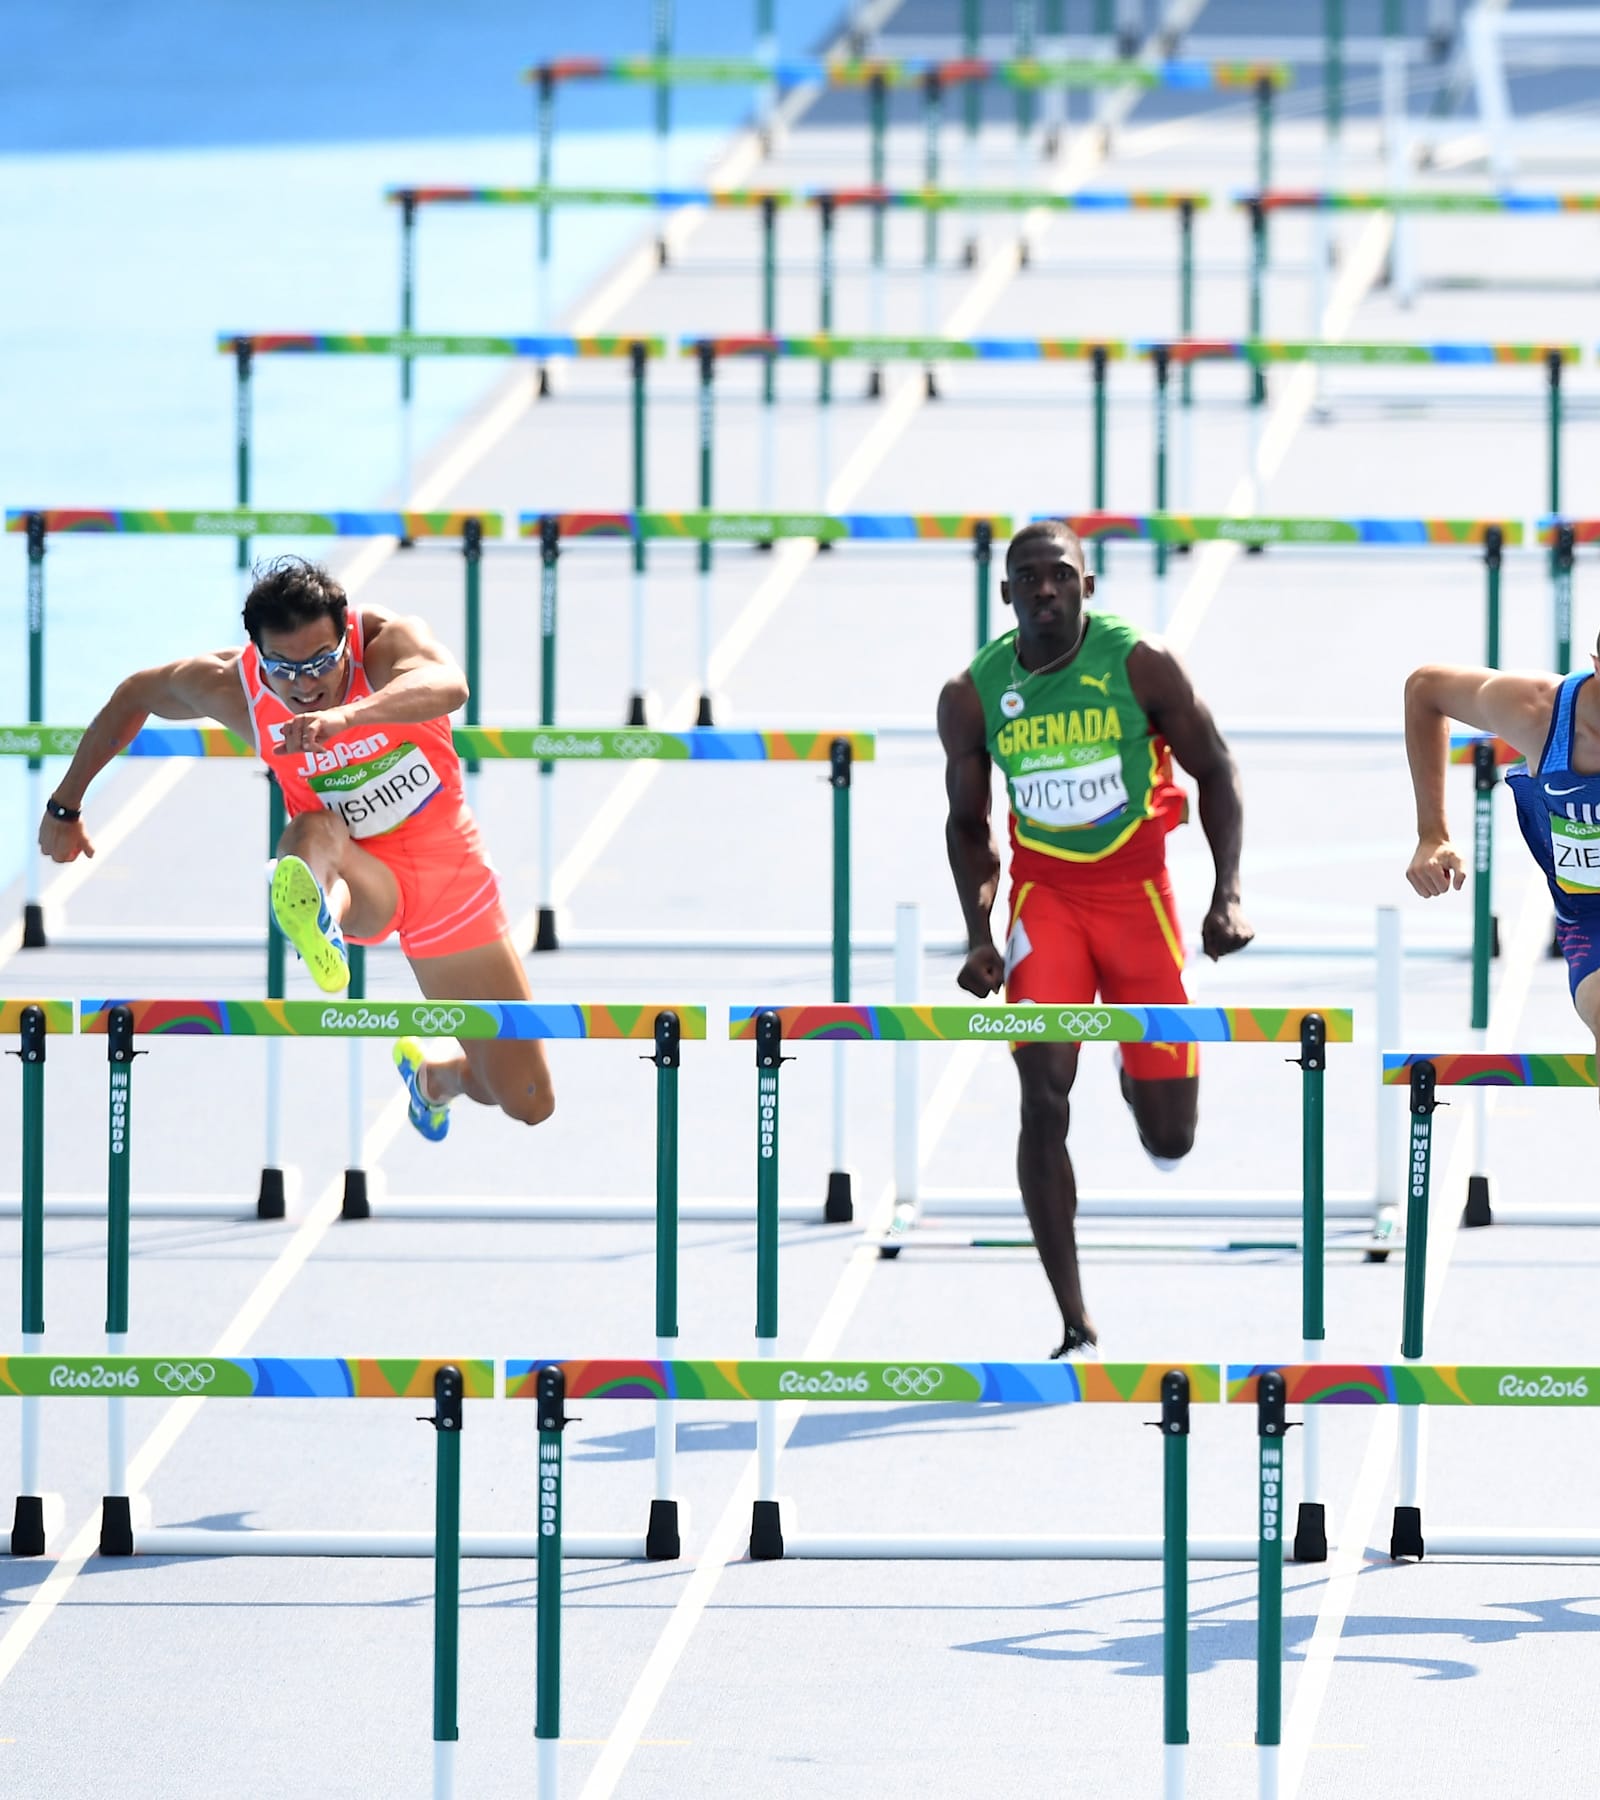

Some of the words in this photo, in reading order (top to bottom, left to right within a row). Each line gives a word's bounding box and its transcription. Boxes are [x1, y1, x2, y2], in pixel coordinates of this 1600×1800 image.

[298, 732, 390, 778] Japan
[997, 706, 1123, 757] GRENADA
[320, 1007, 400, 1030] Rio2016
[968, 1013, 1046, 1034] Rio2016
[111, 1089, 127, 1154] MONDO
[760, 1094, 776, 1158] MONDO
[1412, 1137, 1428, 1198] MONDO
[49, 1364, 140, 1388] Rio2016
[778, 1370, 870, 1393] Rio2016
[1498, 1374, 1589, 1398] Rio2016
[540, 1463, 559, 1537] MONDO
[1262, 1468, 1280, 1541] MONDO
